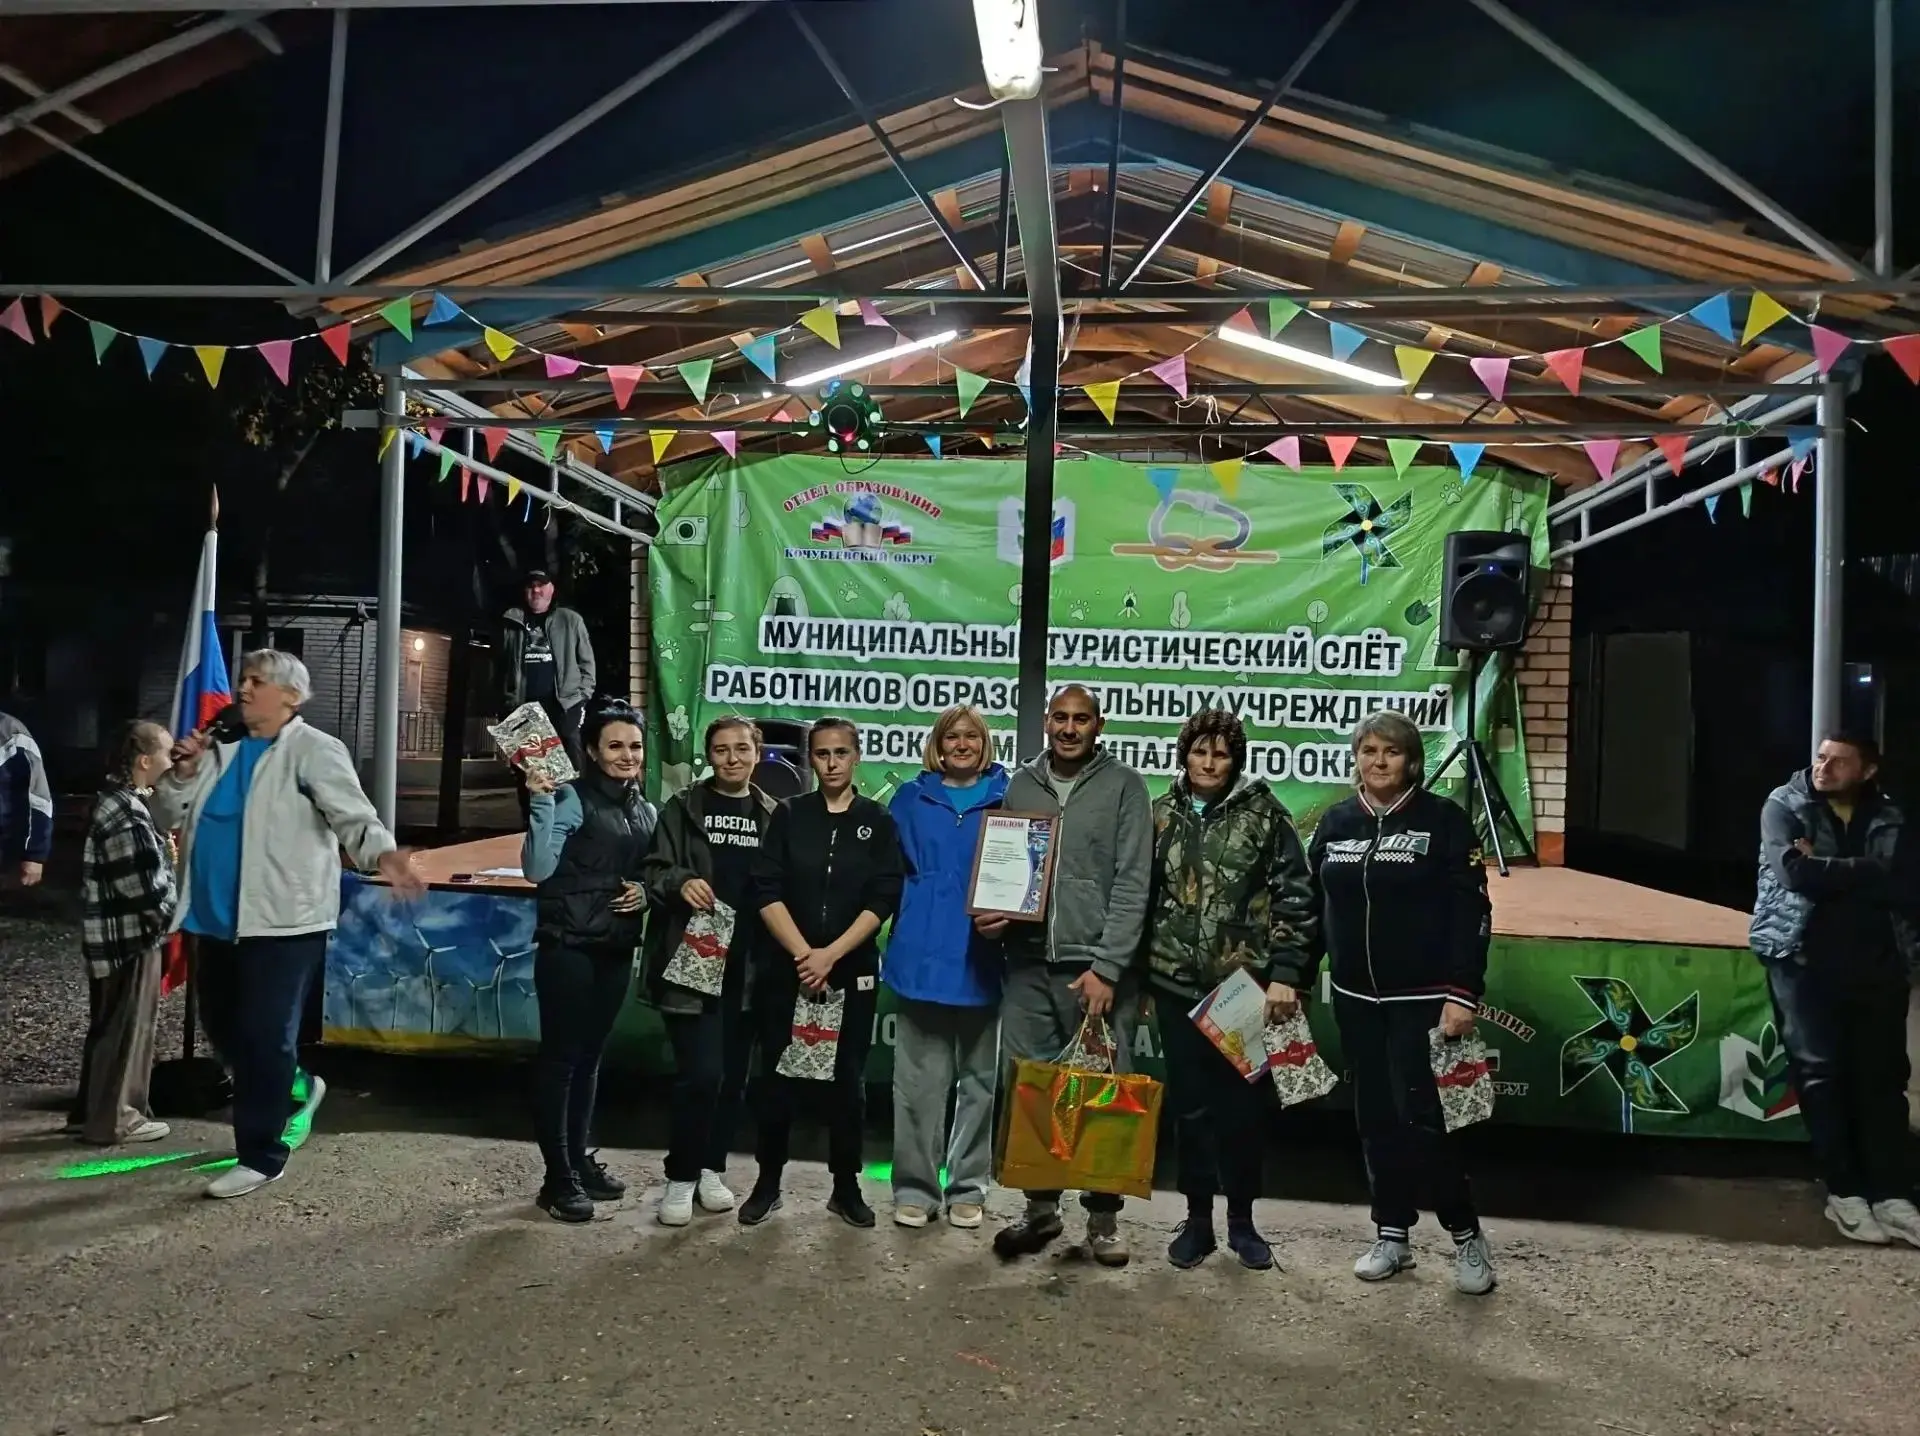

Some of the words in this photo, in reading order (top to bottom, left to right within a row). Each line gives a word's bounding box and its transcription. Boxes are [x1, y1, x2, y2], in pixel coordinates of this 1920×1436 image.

[783, 484, 829, 512] ОТДЕЛ
[835, 481, 942, 518] ОБРАЗОВАНИЯ
[894, 553, 935, 564] ОКРУГ
[763, 621, 1016, 659] МУНИЦИПАЛЬНЫ
[1047, 631, 1307, 668] ТУРИСТИЧЕСКИЙ
[1319, 633, 1402, 671] СЛЁТ
[711, 670, 901, 706] РАБОТНИКОВ
[704, 815, 713, 828] Я
[714, 815, 758, 833] ВСЕГДА
[707, 832, 727, 844] УДУ
[727, 834, 759, 848] РЯДОМ
